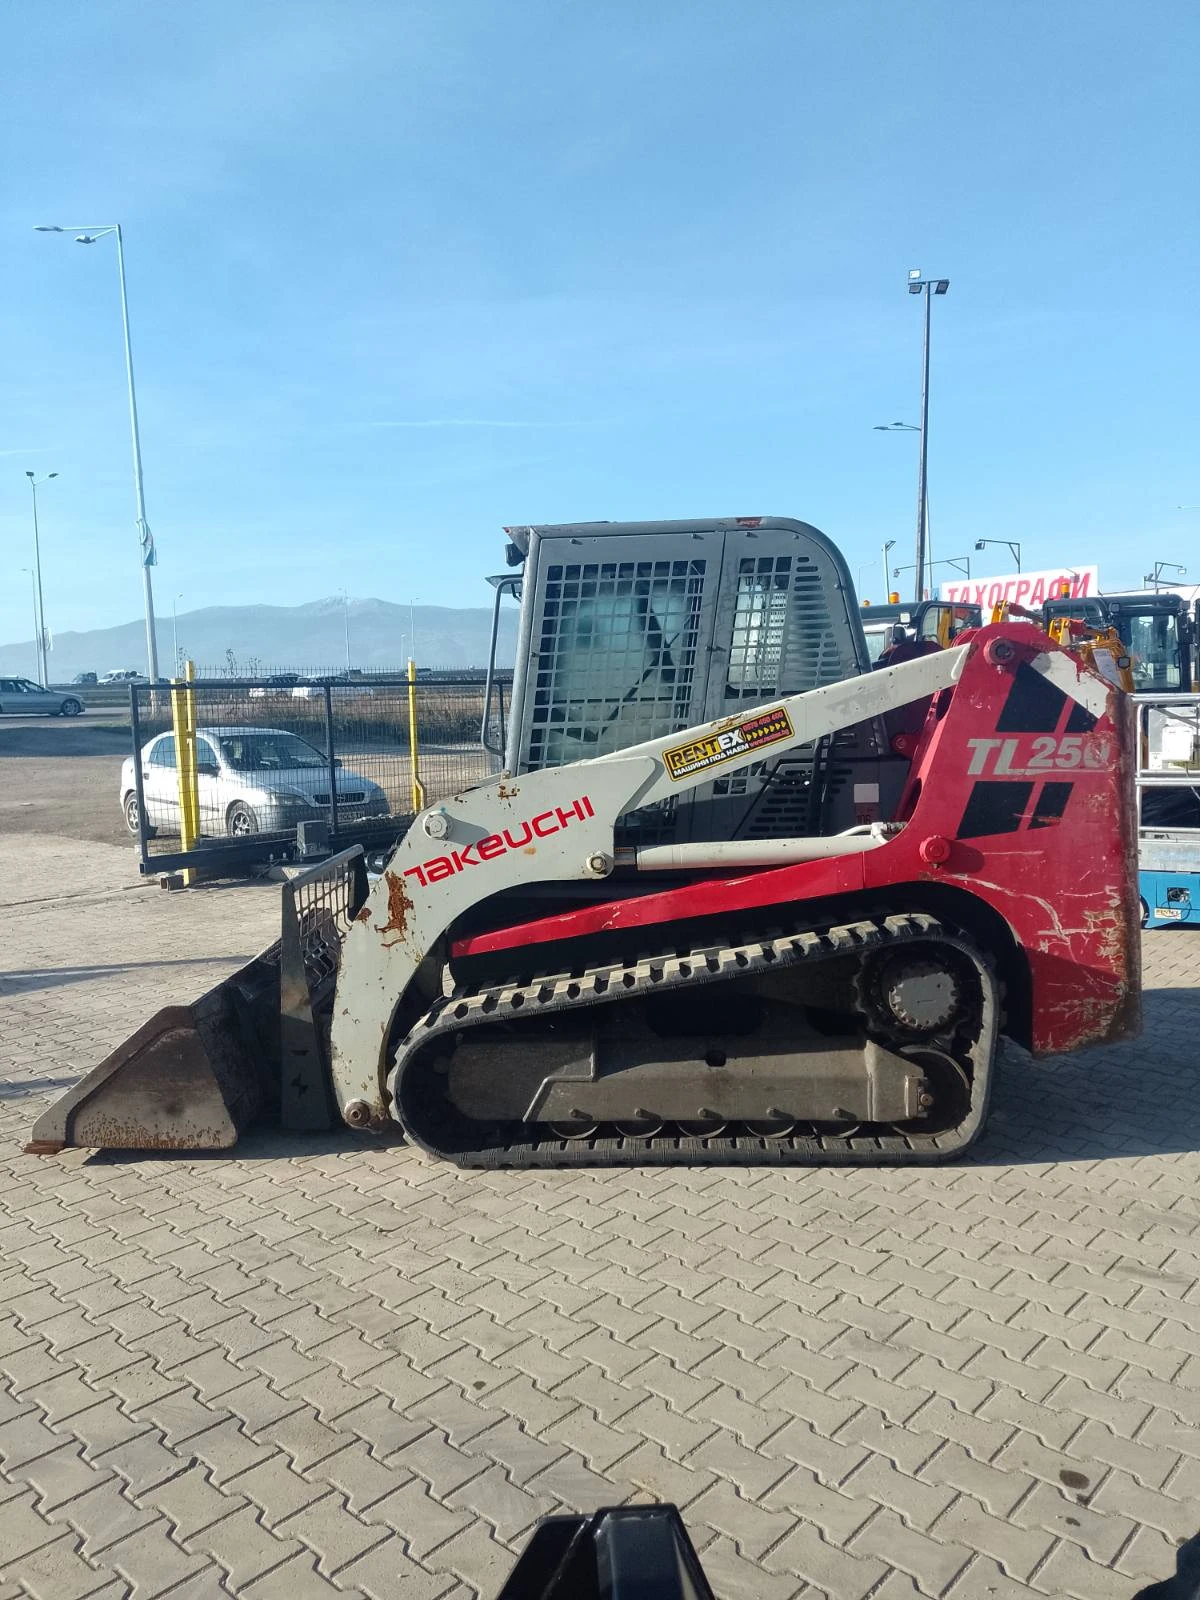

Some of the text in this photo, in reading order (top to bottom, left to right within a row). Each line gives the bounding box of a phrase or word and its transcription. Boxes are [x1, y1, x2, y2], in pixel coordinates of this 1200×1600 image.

[948, 572, 1091, 610] ТАХОГРАФИ
[671, 728, 744, 768] RENTEX
[673, 742, 750, 777] МАШИНИ ПОД НАЕМ
